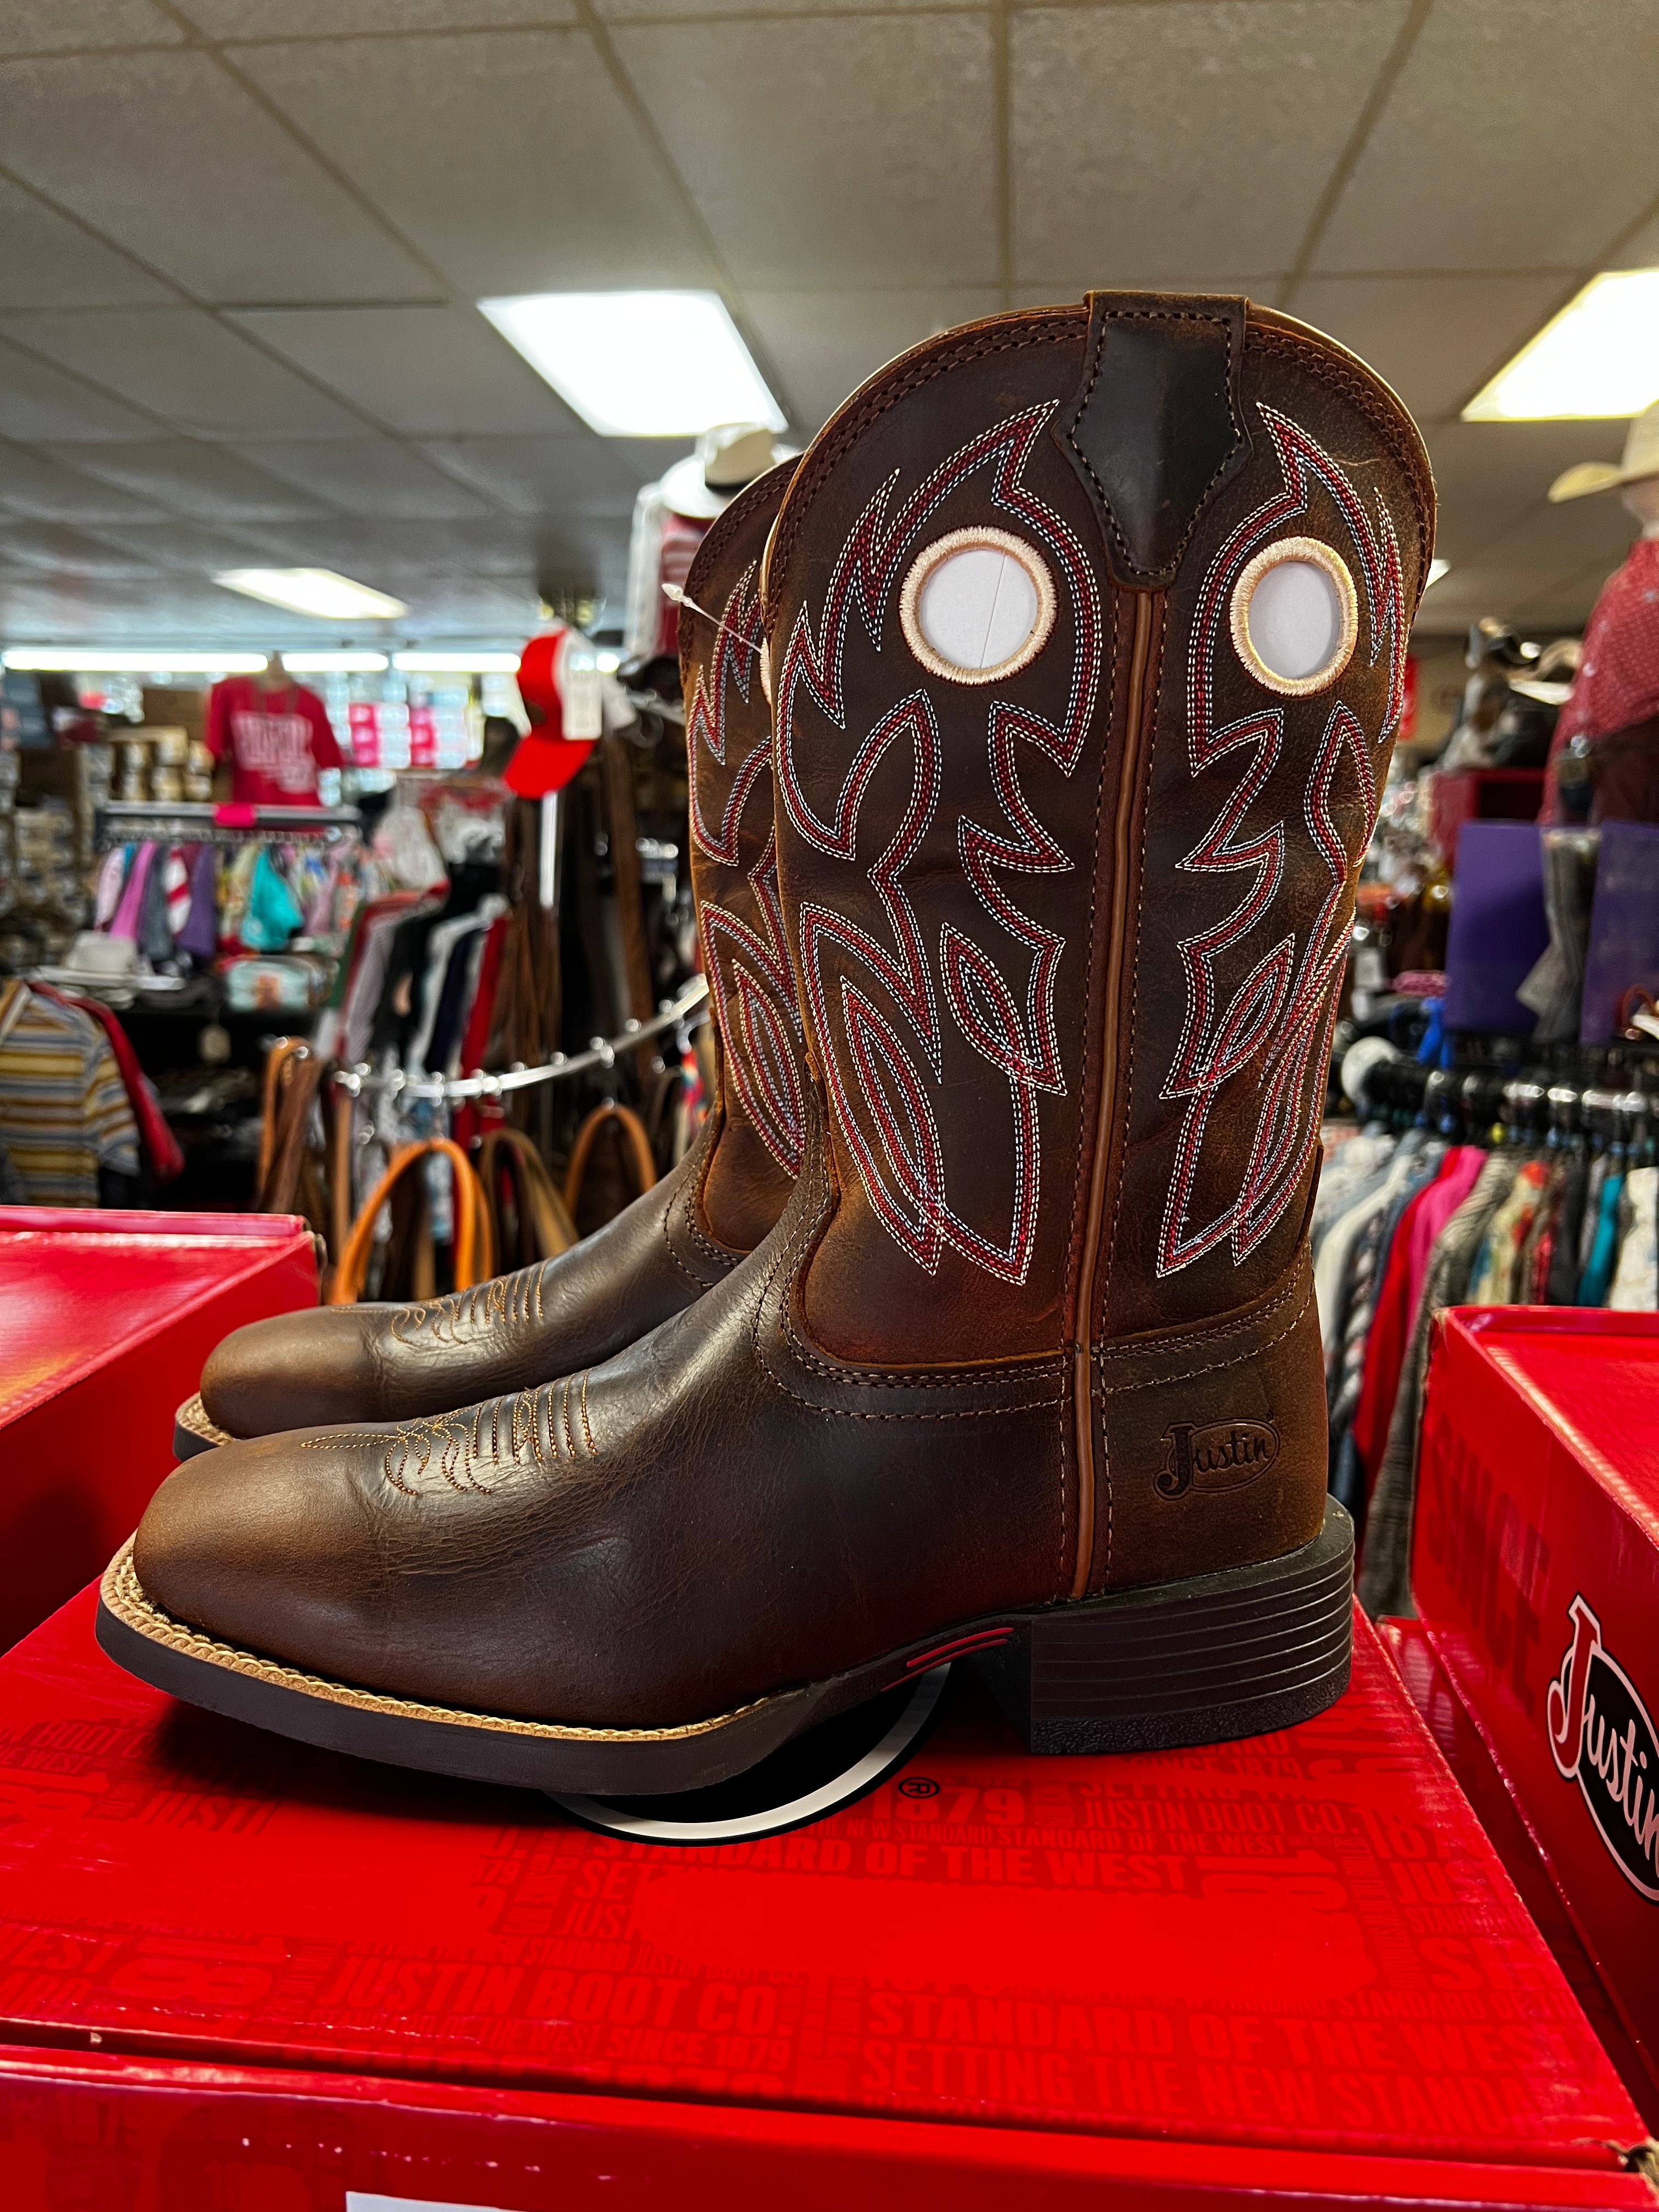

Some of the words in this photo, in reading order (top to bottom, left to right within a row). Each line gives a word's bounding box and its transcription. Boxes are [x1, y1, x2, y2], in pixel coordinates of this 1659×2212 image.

[1154, 1421, 1271, 1501] Justin
[27, 1720, 131, 1754] BOOT
[20, 1748, 92, 1774] WEST
[847, 1819, 893, 1839] NEW
[895, 1822, 992, 1844] STANDARD
[997, 1827, 1121, 1851] STANDARD
[1128, 1831, 1159, 1852] OF
[1165, 1833, 1212, 1853] THE
[1216, 1835, 1286, 1856] WEST
[1079, 1800, 1191, 1830] JUSTIN
[1196, 1802, 1286, 1833] BOOT
[1295, 1803, 1359, 1834] CO.
[865, 1842, 928, 1877] OF
[941, 1844, 1035, 1883] THE
[1045, 1849, 1187, 1891] WEST
[523, 1938, 631, 1971] STANDARD
[317, 1956, 524, 2015] JUSTIN
[525, 1969, 690, 2027] BOOT
[697, 1982, 793, 2036] CO.
[1333, 1989, 1487, 2020] STANDARD
[605, 2026, 707, 2064] SINCE
[714, 2034, 791, 2072] 1879
[868, 1990, 1175, 2055] STANDARD
[1189, 2013, 1263, 2061] OF
[1274, 2018, 1398, 2068] THE
[1398, 2023, 1580, 2073] WEST
[860, 2039, 1075, 2106] SETTING
[1085, 2055, 1189, 2114] THE
[1197, 2062, 1319, 2125] NEW
